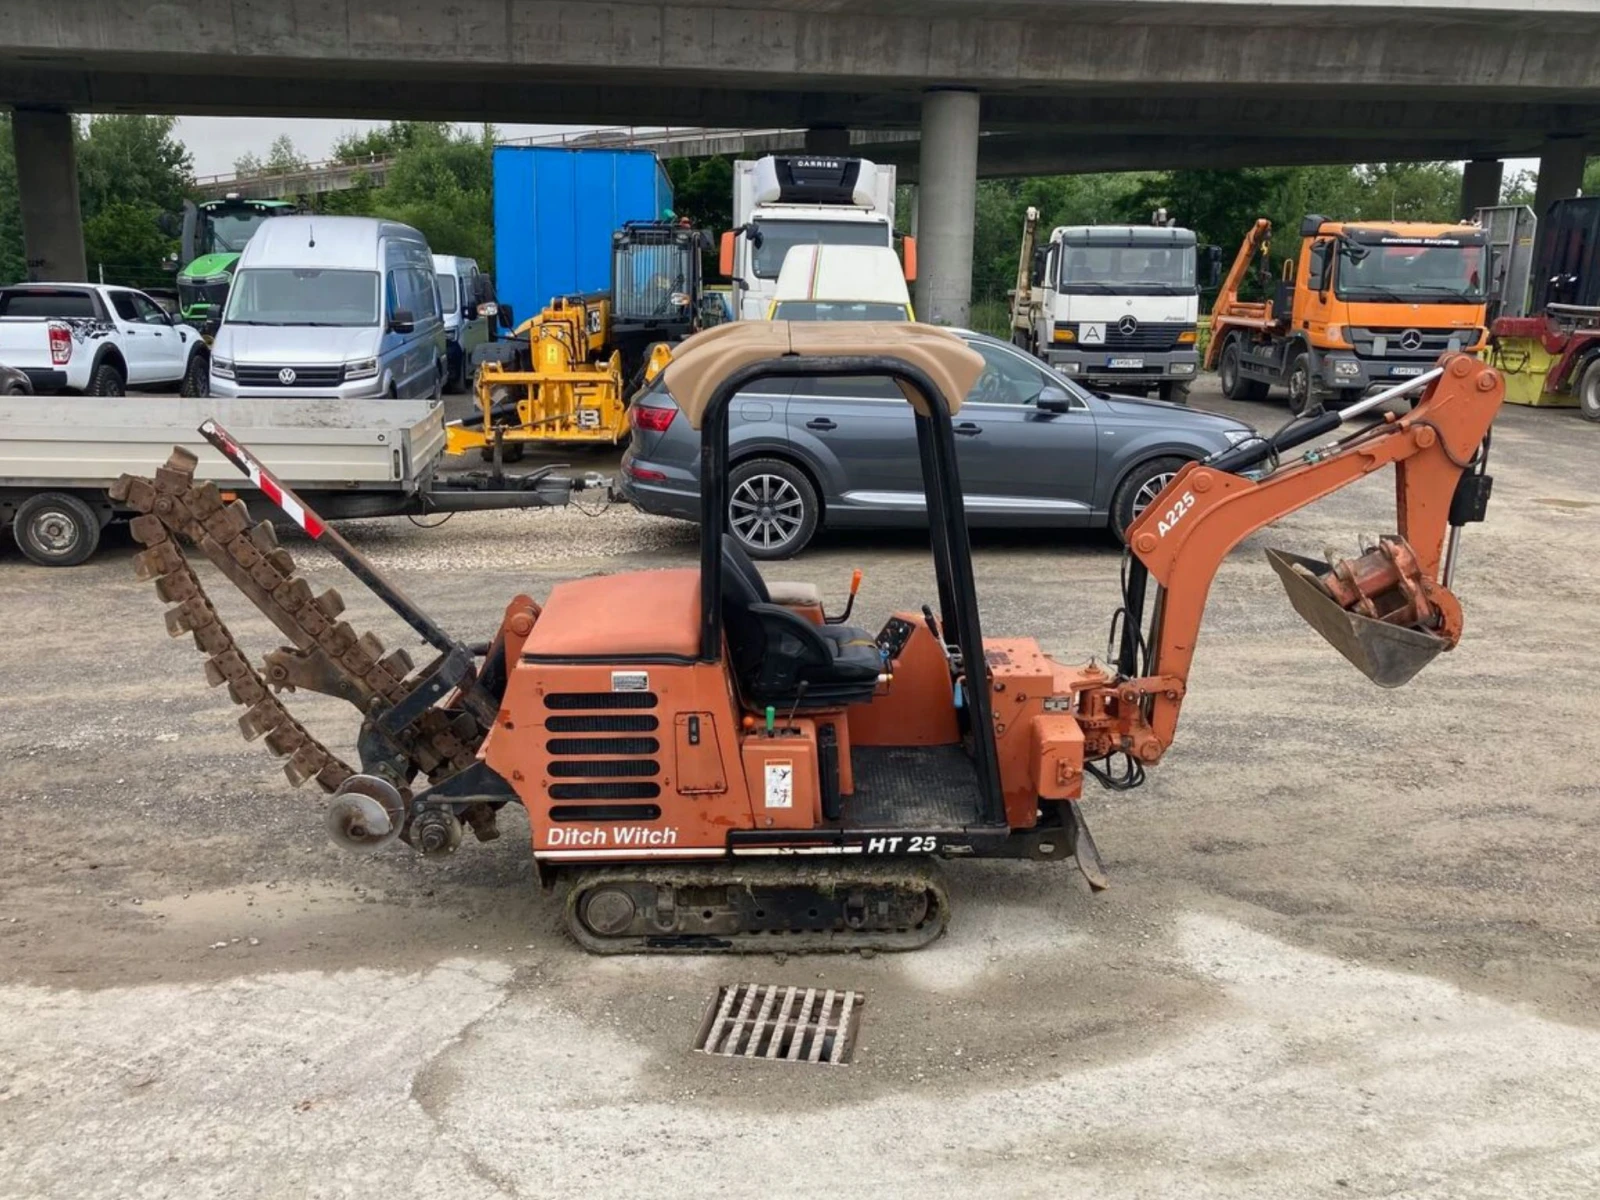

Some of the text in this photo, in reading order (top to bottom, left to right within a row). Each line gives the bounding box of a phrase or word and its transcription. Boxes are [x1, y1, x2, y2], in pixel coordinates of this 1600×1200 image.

[797, 160, 839, 168] CARRIER
[1084, 325, 1100, 341] A
[1157, 491, 1195, 538] A225
[547, 826, 678, 846] Ditch Witch
[868, 836, 937, 854] HT 25
